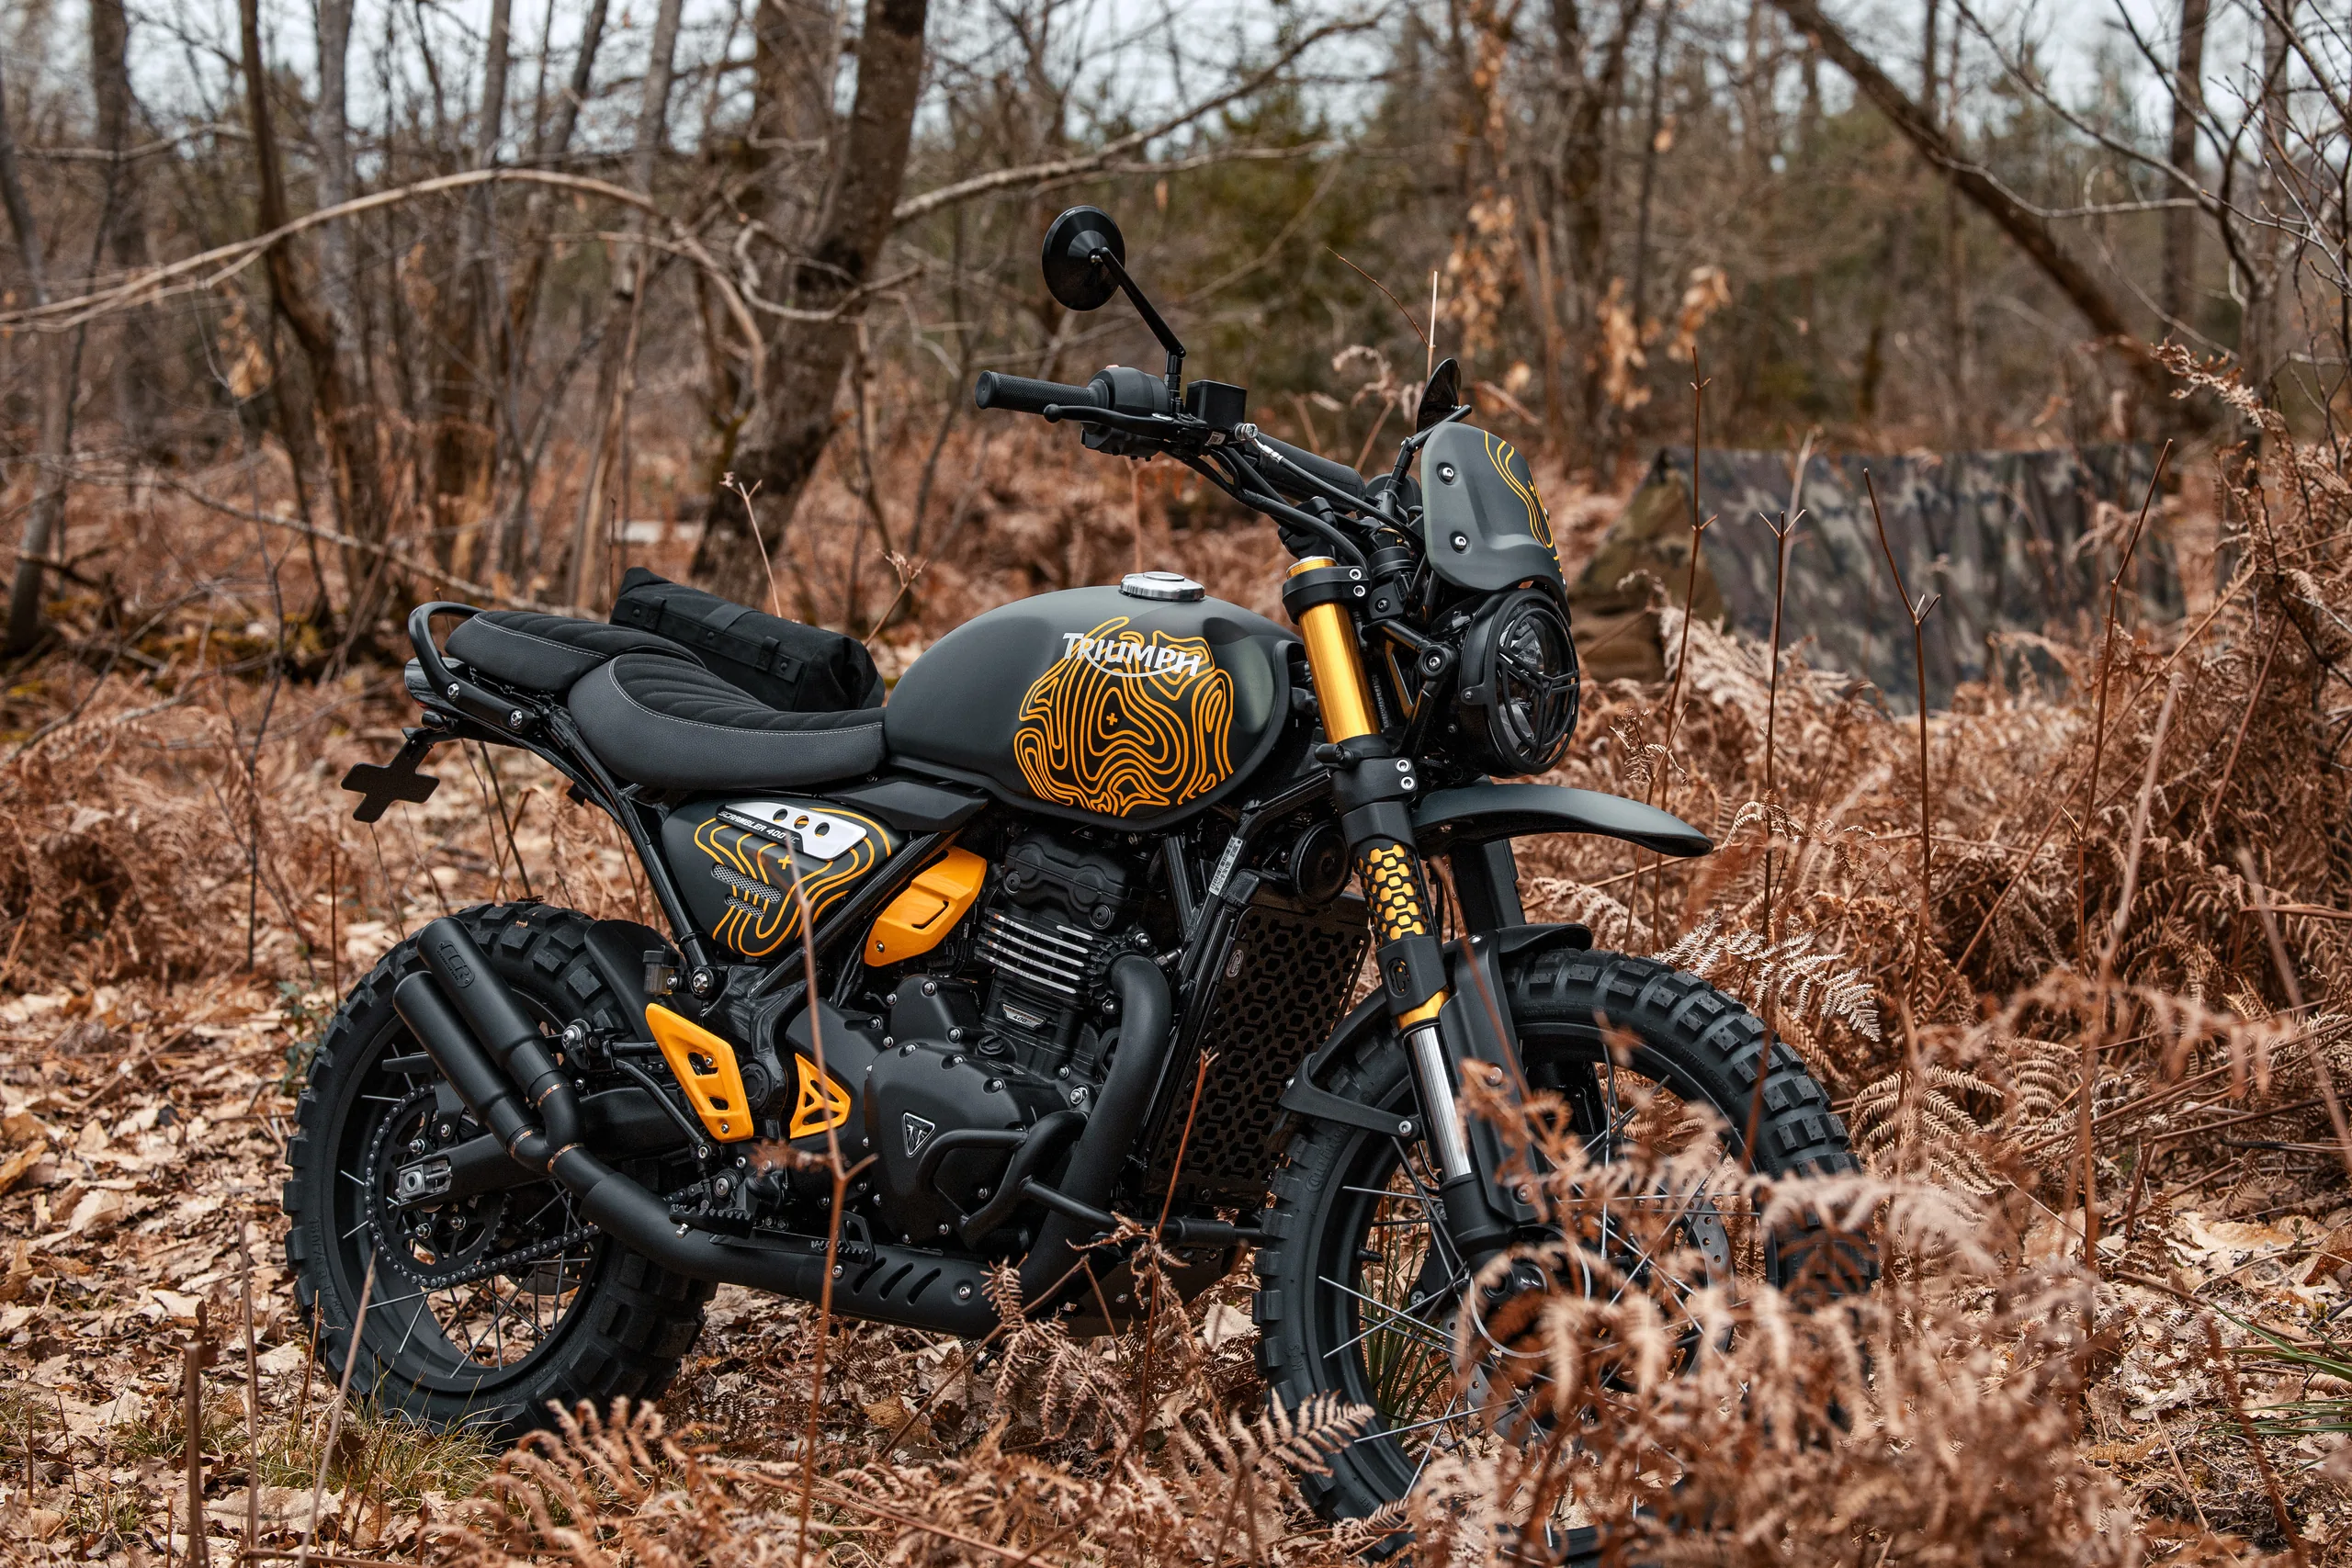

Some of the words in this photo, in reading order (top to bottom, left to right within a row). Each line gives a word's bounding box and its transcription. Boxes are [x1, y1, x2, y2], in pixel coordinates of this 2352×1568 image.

[1062, 632, 1201, 678] TRIUMPH
[718, 810, 767, 832] SCRAMBLER
[766, 829, 786, 840] 400
